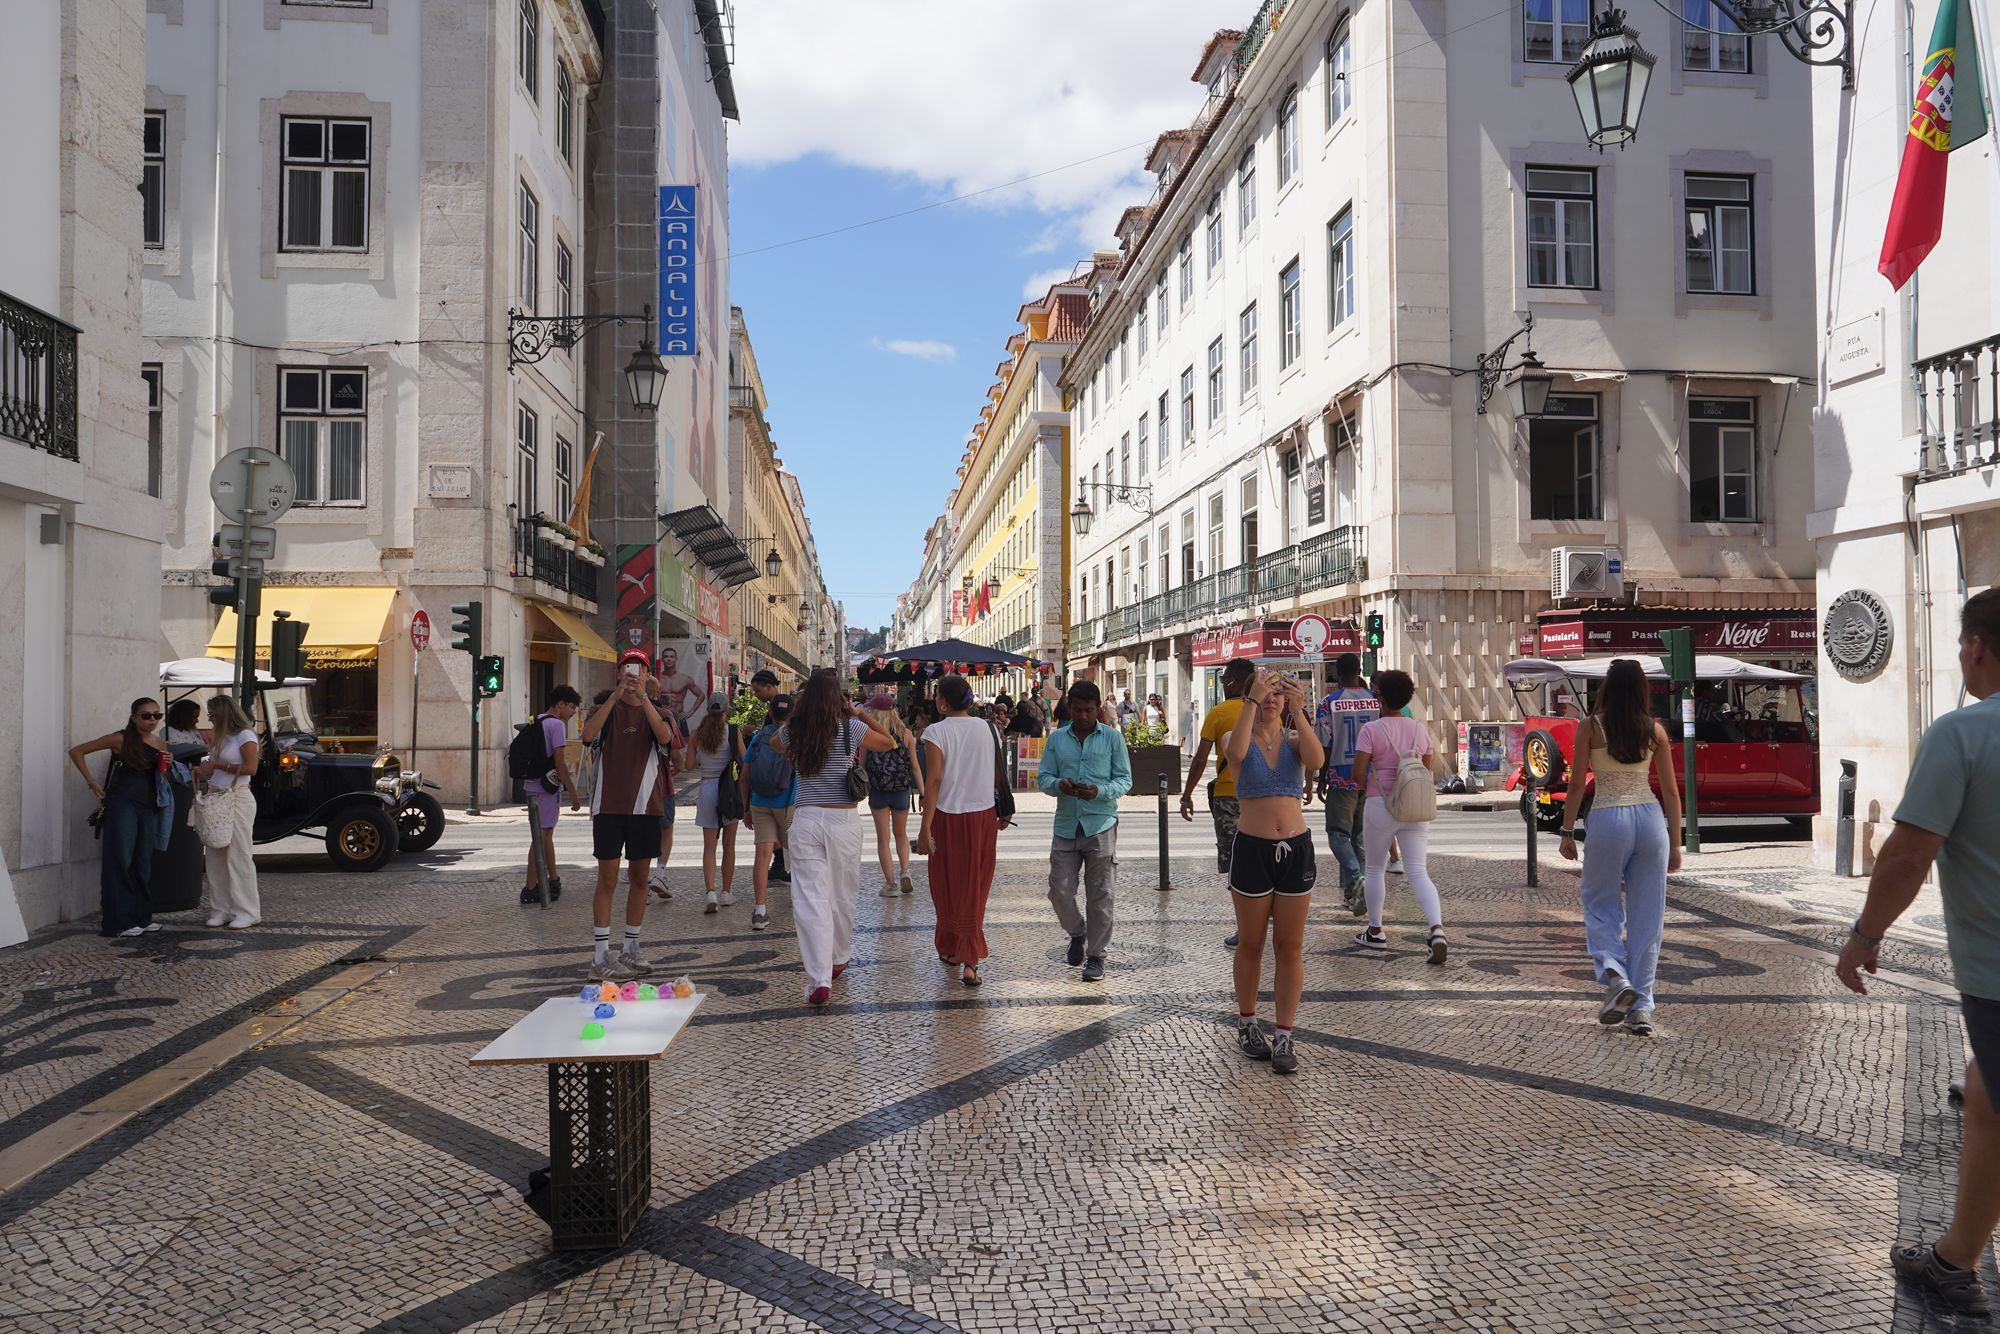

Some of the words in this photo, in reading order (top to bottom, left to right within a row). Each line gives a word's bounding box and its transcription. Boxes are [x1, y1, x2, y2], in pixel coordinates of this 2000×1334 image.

[667, 222, 688, 352] ANDALUGA
[1847, 336, 1861, 346] RUA
[1840, 347, 1869, 362] AUGUSTA
[1373, 618, 1381, 628] 2
[1543, 631, 1579, 642] Pastelaria
[1715, 621, 1770, 648] Néné
[1790, 631, 1818, 639] Rest
[493, 659, 500, 671] 2
[1334, 699, 1380, 711] SUPREME
